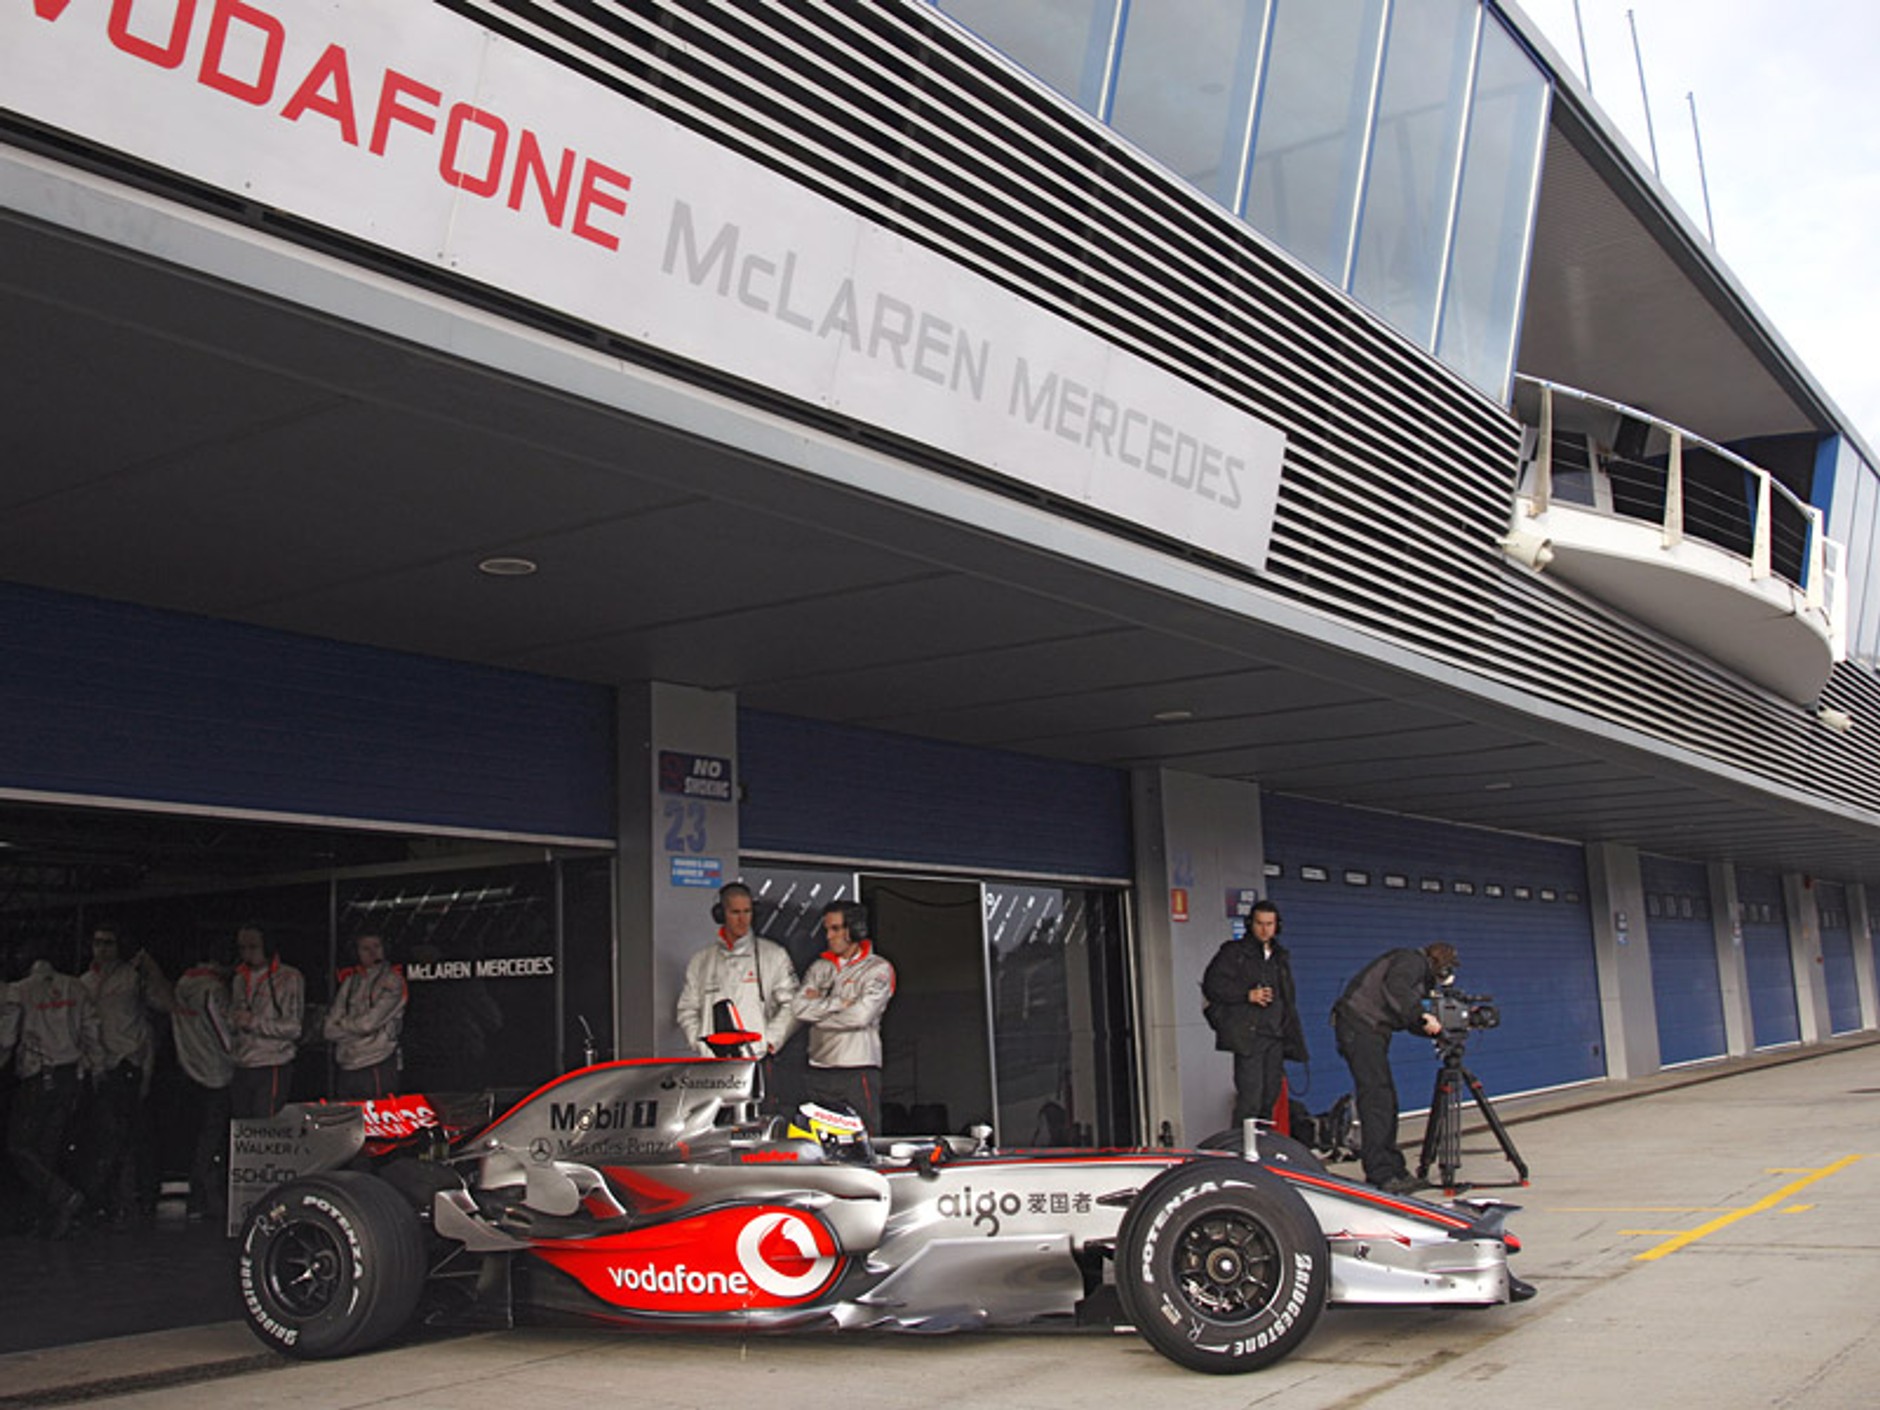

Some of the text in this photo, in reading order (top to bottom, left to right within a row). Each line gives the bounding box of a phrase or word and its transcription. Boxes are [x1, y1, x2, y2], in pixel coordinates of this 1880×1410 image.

[31, 0, 1245, 510] ODAFONE McLAREN MERCEDES
[692, 758, 722, 778] NO
[664, 801, 707, 852] 23
[407, 956, 554, 981] McLAREN MERCEDES
[679, 1074, 747, 1090] Santander
[551, 1100, 626, 1131] Mobil
[234, 1140, 291, 1155] WALKER
[937, 1186, 1093, 1237] aigo 爱国者
[1141, 1181, 1220, 1284] POTENZA
[303, 1195, 363, 1279] POTENZA
[607, 1261, 749, 1295] vodafone
[1232, 1251, 1314, 1357] BRIDGESTONE
